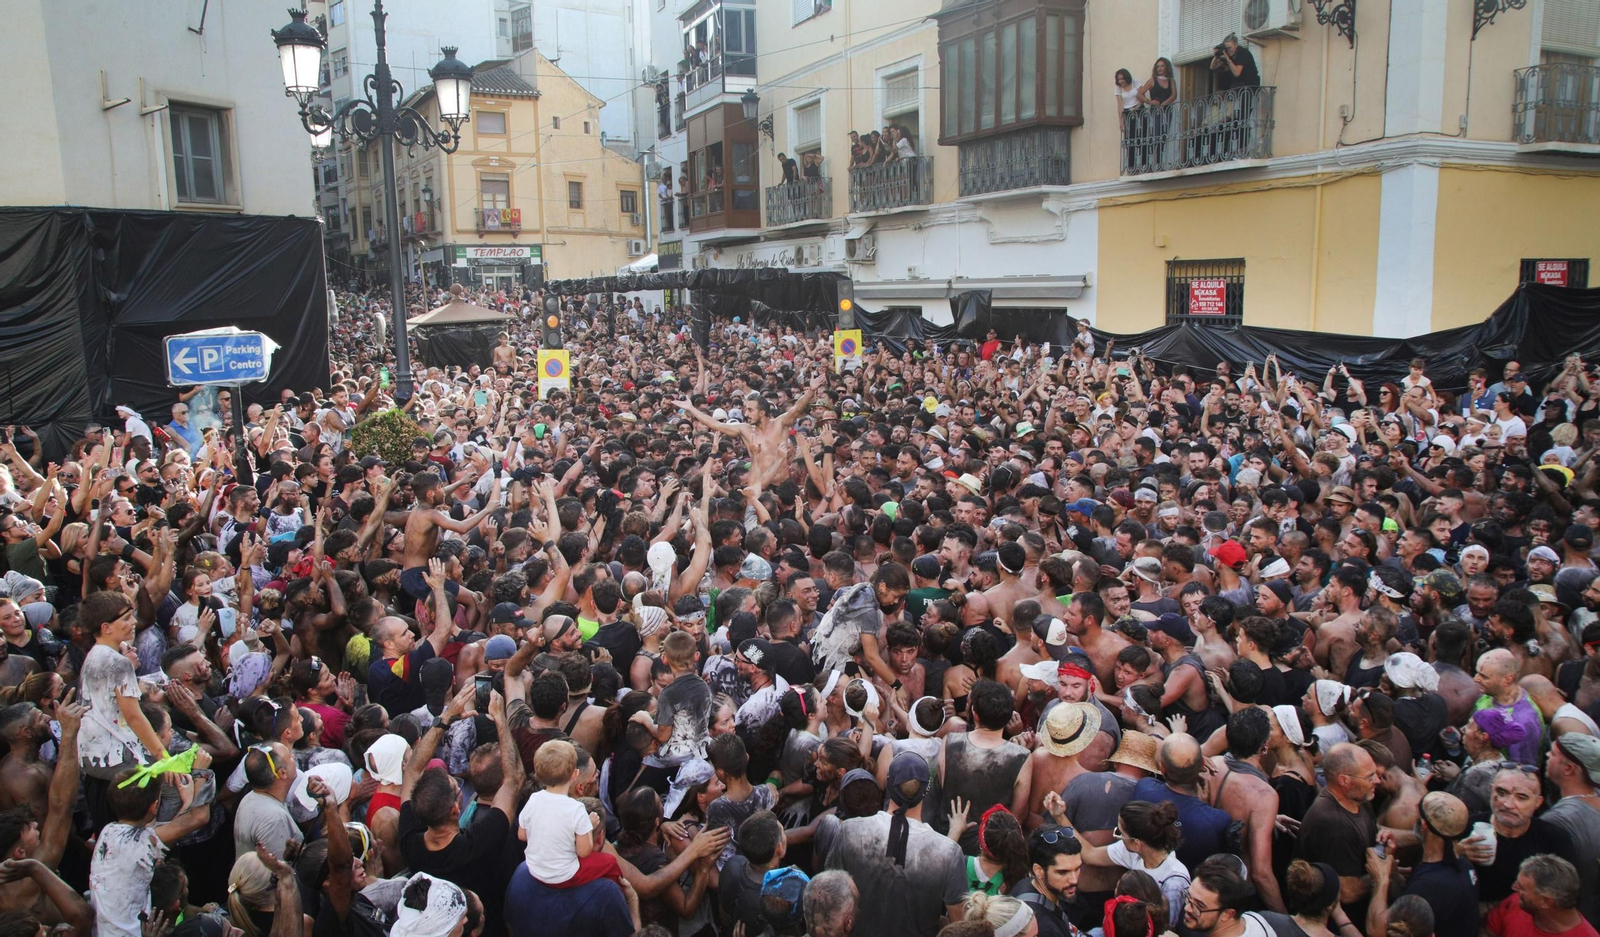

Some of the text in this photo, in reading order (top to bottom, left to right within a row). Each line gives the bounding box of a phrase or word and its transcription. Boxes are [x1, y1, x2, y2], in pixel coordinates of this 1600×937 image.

[473, 248, 524, 256] TEMPLAO
[771, 253, 777, 266] de
[225, 345, 261, 354] Parking
[202, 349, 219, 370] P
[229, 360, 262, 370] Centro
